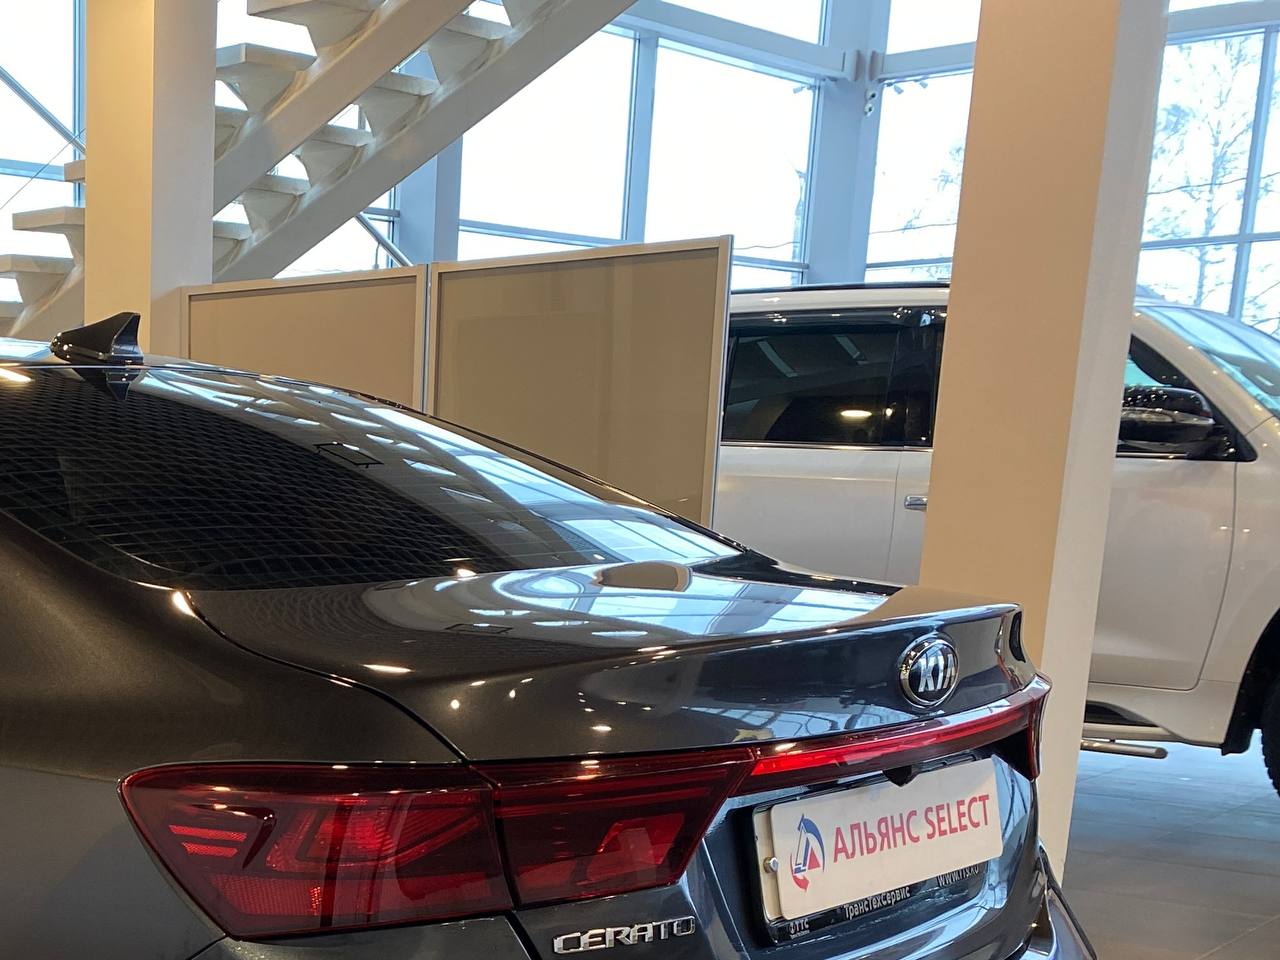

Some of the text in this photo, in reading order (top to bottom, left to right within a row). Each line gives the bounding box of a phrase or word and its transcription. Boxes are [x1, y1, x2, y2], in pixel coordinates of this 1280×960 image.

[918, 653, 956, 692] KIA
[833, 794, 990, 863] АЛЬЯНС SELECT
[553, 915, 696, 954] CERATO
